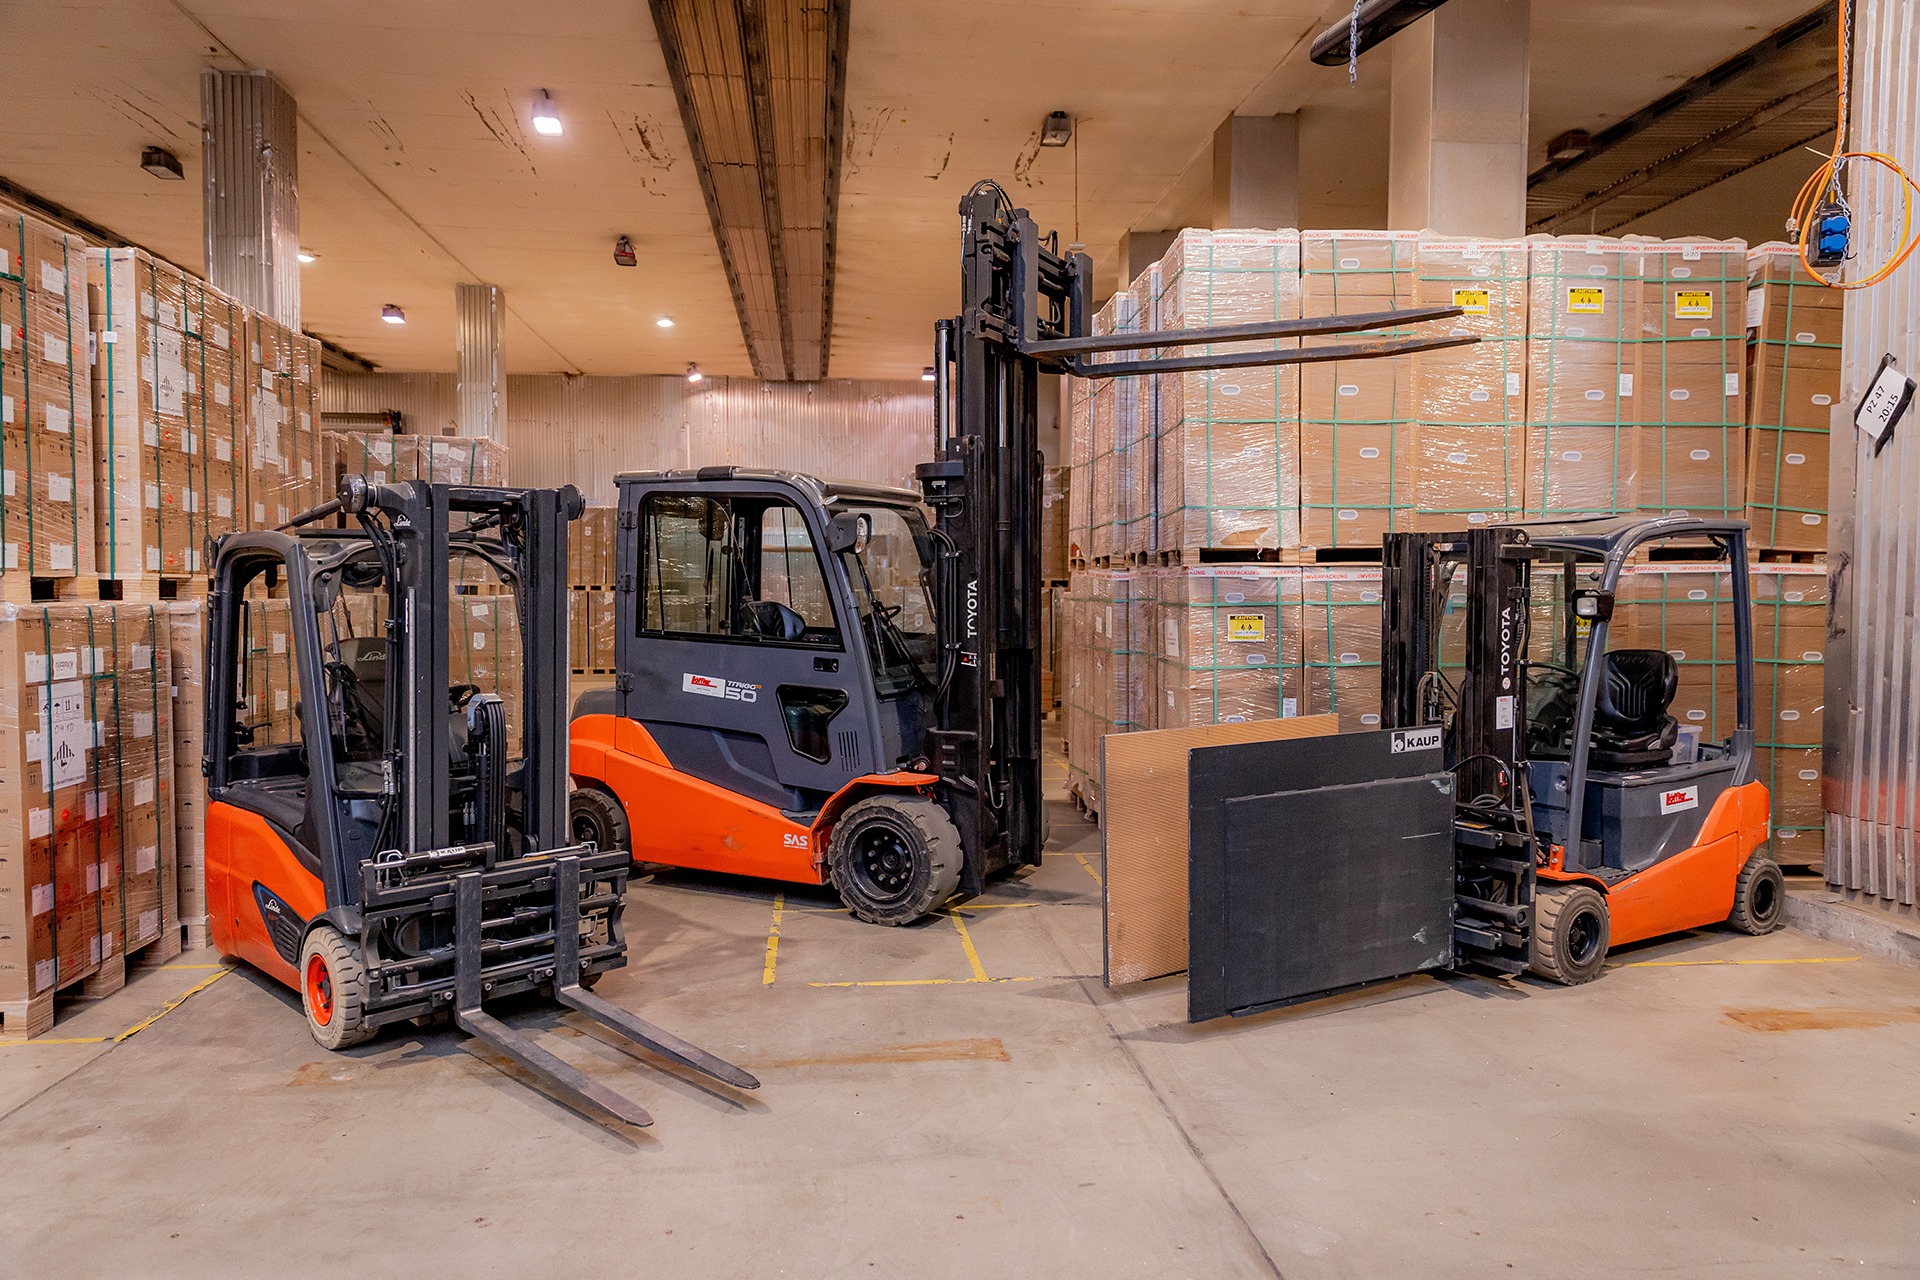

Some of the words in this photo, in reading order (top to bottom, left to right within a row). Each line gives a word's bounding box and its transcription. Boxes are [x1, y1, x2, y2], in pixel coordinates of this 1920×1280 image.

[1866, 400, 1878, 413] PZ
[1875, 386, 1885, 399] 47
[1879, 394, 1899, 422] 20:15
[393, 514, 411, 527] Linde
[967, 580, 977, 638] TOYOTA
[1501, 607, 1511, 675] TOYOTA
[357, 650, 387, 662] Lind
[725, 686, 757, 703] 50
[1407, 735, 1440, 748] KAUP
[783, 833, 808, 847] SAS
[440, 847, 464, 855] KAUP
[265, 899, 280, 914] Linde
